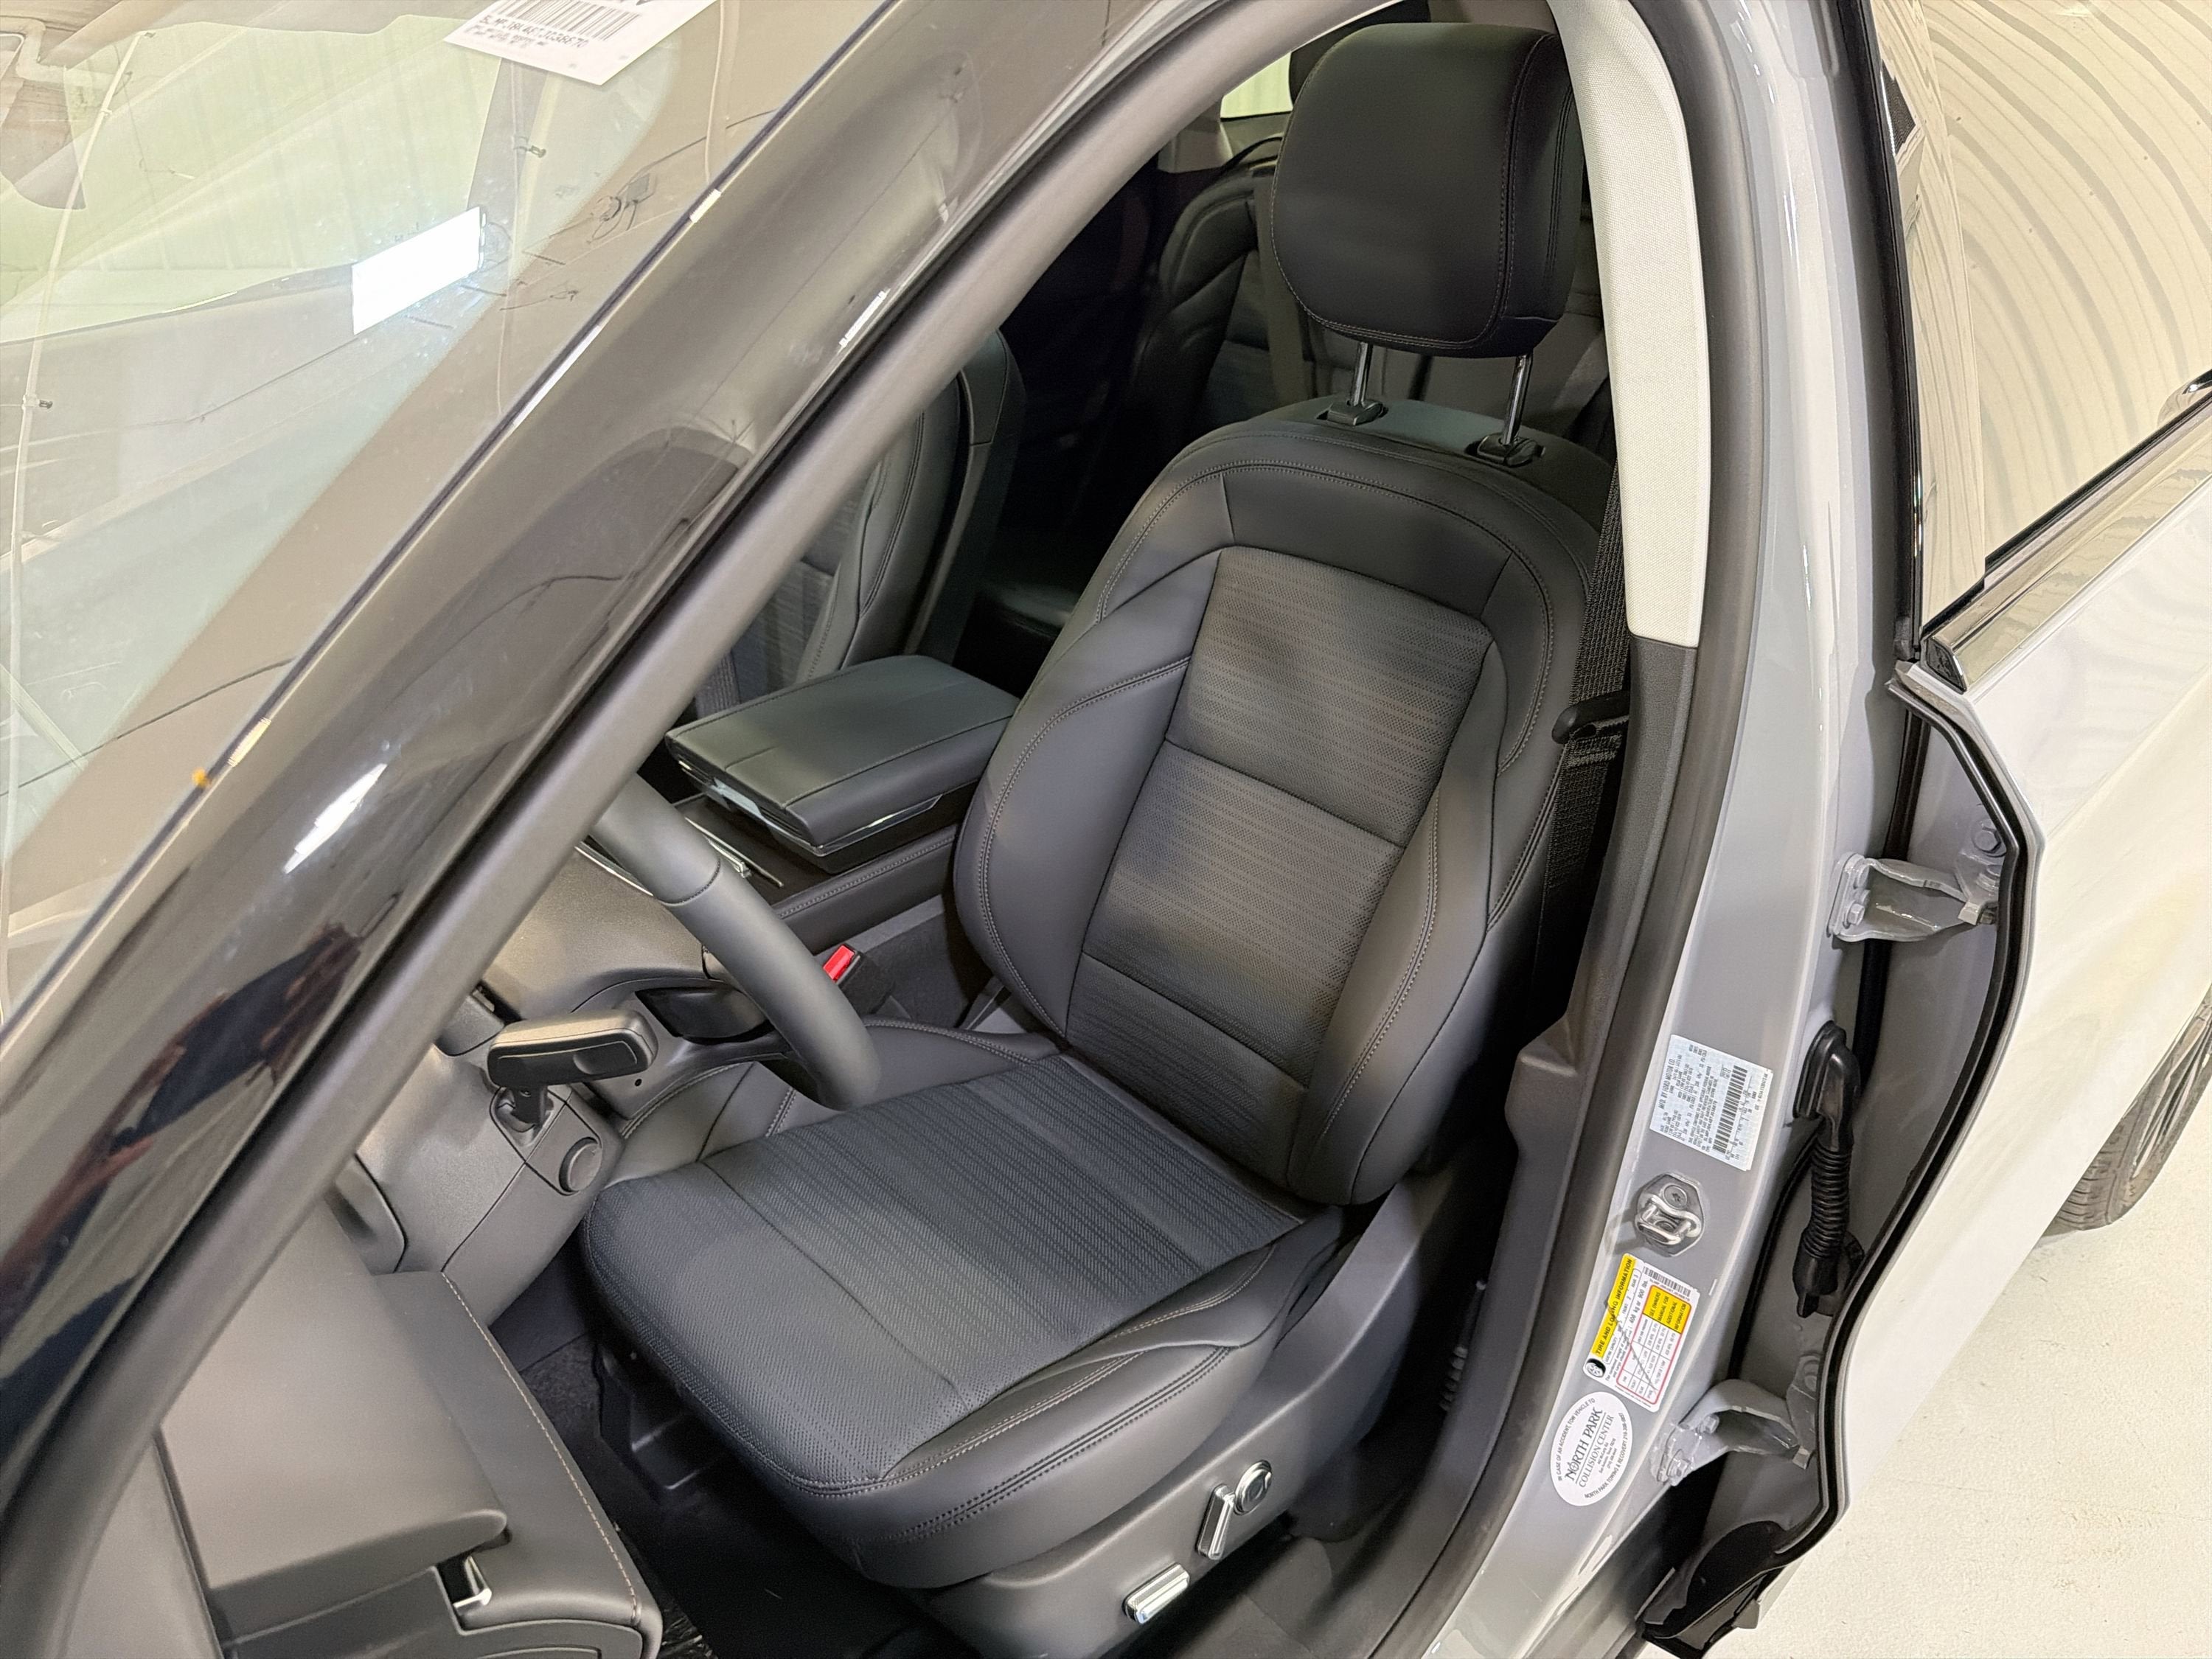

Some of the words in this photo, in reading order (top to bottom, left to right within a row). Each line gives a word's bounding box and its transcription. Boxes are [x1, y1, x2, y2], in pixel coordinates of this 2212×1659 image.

[1662, 1079, 1670, 1092] FORD
[1665, 1065, 1673, 1080] MOTOR
[1596, 1340, 1604, 1354] TIRE
[1602, 1326, 1610, 1340] AND
[1614, 1258, 1633, 1299] INFORMATION
[1632, 1305, 1639, 1313] kg
[1657, 1304, 1666, 1321] MANUAL
[1665, 1301, 1677, 1324] ADDITIONAL
[1673, 1302, 1687, 1330] INFORMATION
[1558, 1424, 1571, 1446] ACCIDENT,
[1567, 1415, 1576, 1424] TOW
[1573, 1401, 1590, 1416] VEHICLE
[1564, 1439, 1589, 1481] NORTH
[1582, 1407, 1603, 1439] PARK
[1578, 1444, 1602, 1488] COLLISION
[1596, 1414, 1614, 1445] CENTER
[1583, 1489, 1599, 1498] NORTH
[1597, 1482, 1609, 1492] PARK
[1606, 1467, 1619, 1482] TOWING
[1618, 1440, 1627, 1463] RECOVERY
